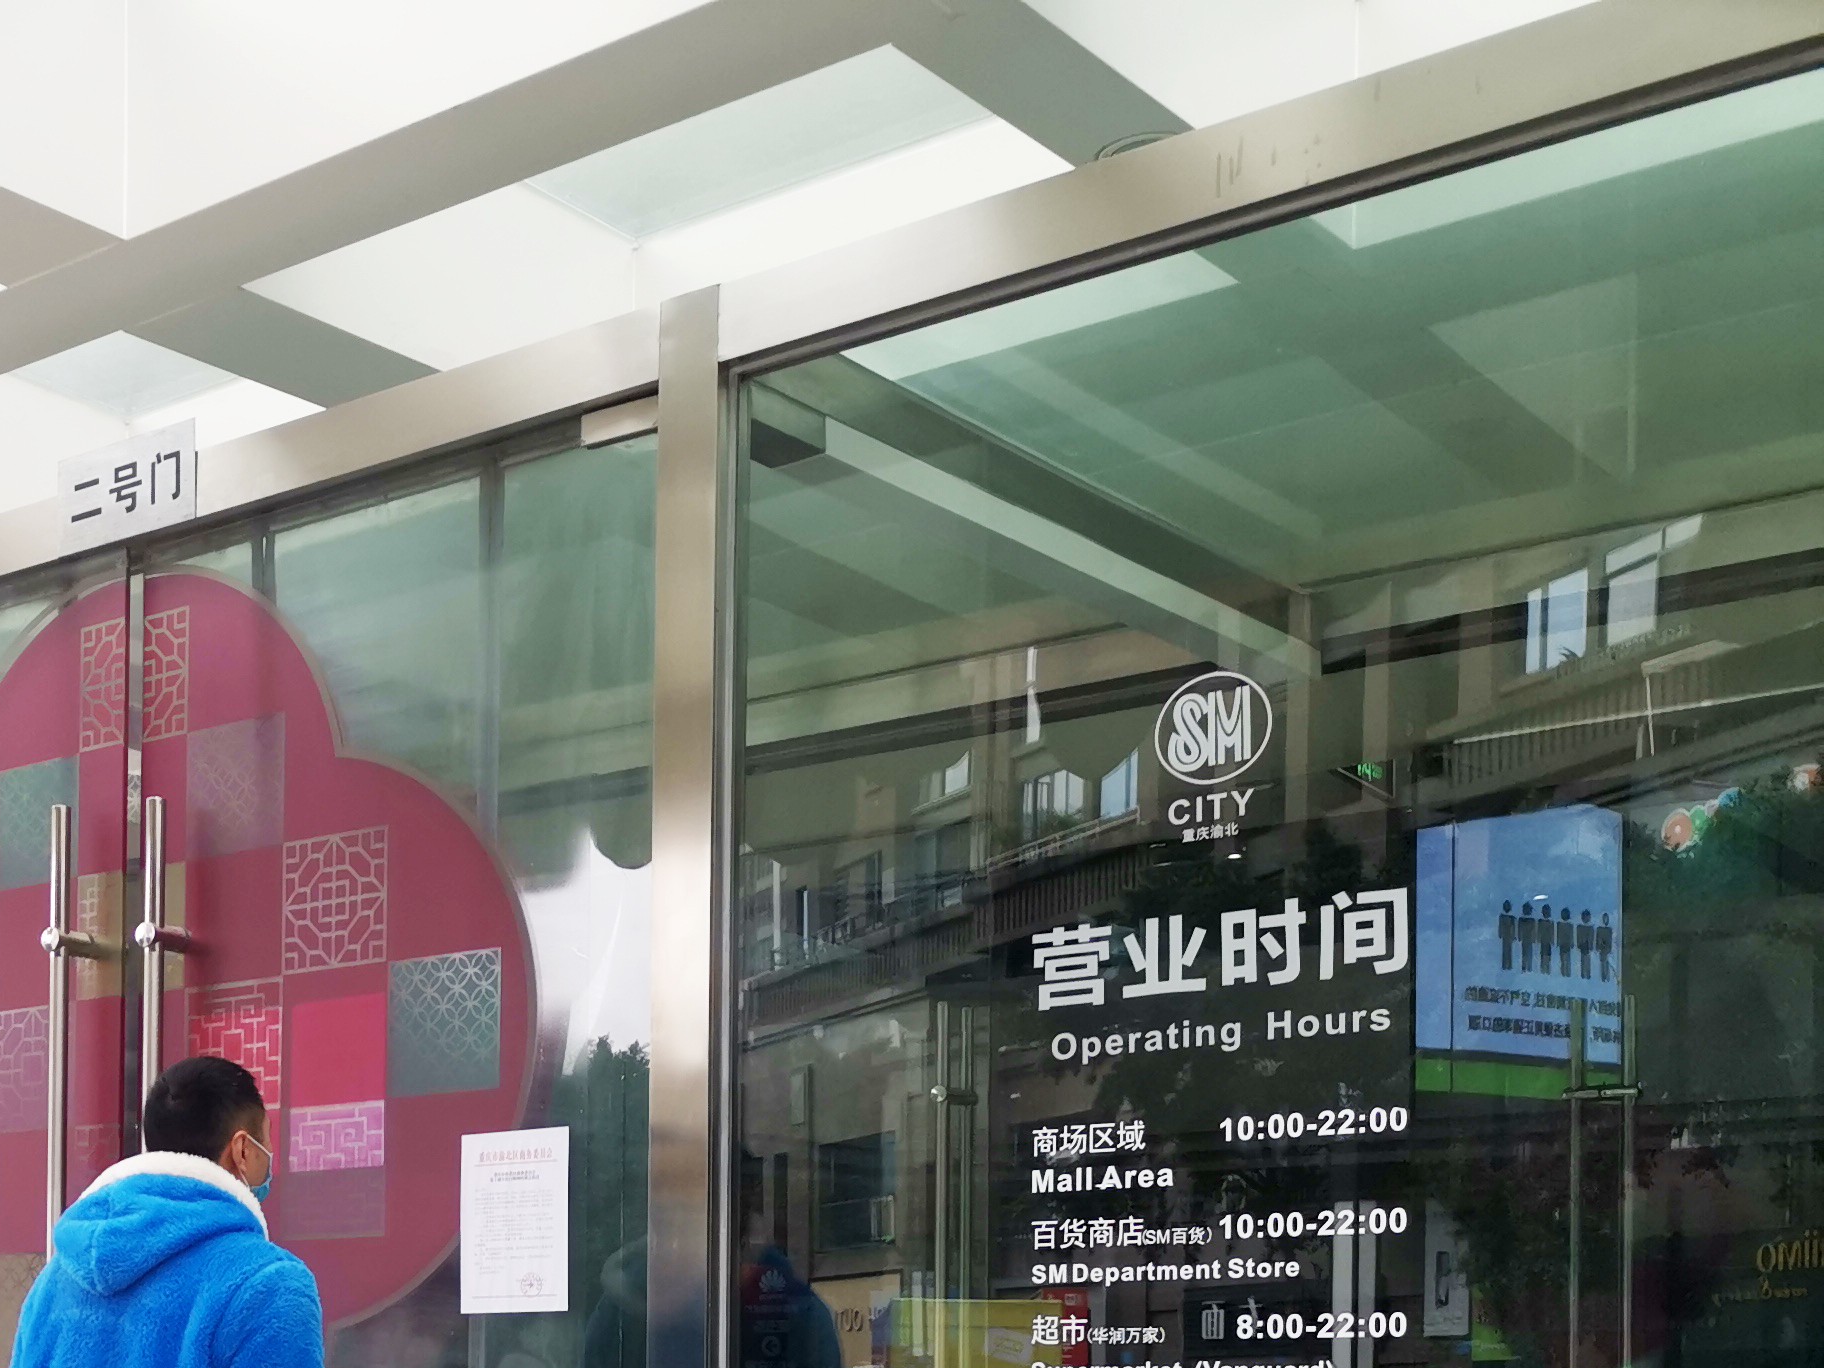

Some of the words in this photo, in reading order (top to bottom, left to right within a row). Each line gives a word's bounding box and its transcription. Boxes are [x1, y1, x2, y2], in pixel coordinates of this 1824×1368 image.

[71, 450, 181, 523] 二号门
[1164, 681, 1255, 775] SM
[1167, 788, 1254, 827] CITY
[1181, 823, 1239, 844] 重庆渝北
[1032, 887, 1409, 1012] 营业时间
[1050, 1018, 1243, 1066] Operating
[1266, 1007, 1392, 1041] Hours
[1031, 1120, 1147, 1157] 商场区域
[1218, 1106, 1409, 1144] 10:00-22:00
[1031, 1166, 1094, 1195] Mall
[1099, 1165, 1175, 1191] Area
[1218, 1206, 1408, 1242] 10:00-22:00
[1031, 1263, 1068, 1286] SM
[1072, 1258, 1221, 1289] Department
[1227, 1257, 1301, 1280] Store
[1235, 1310, 1408, 1341] 8:00-22:00
